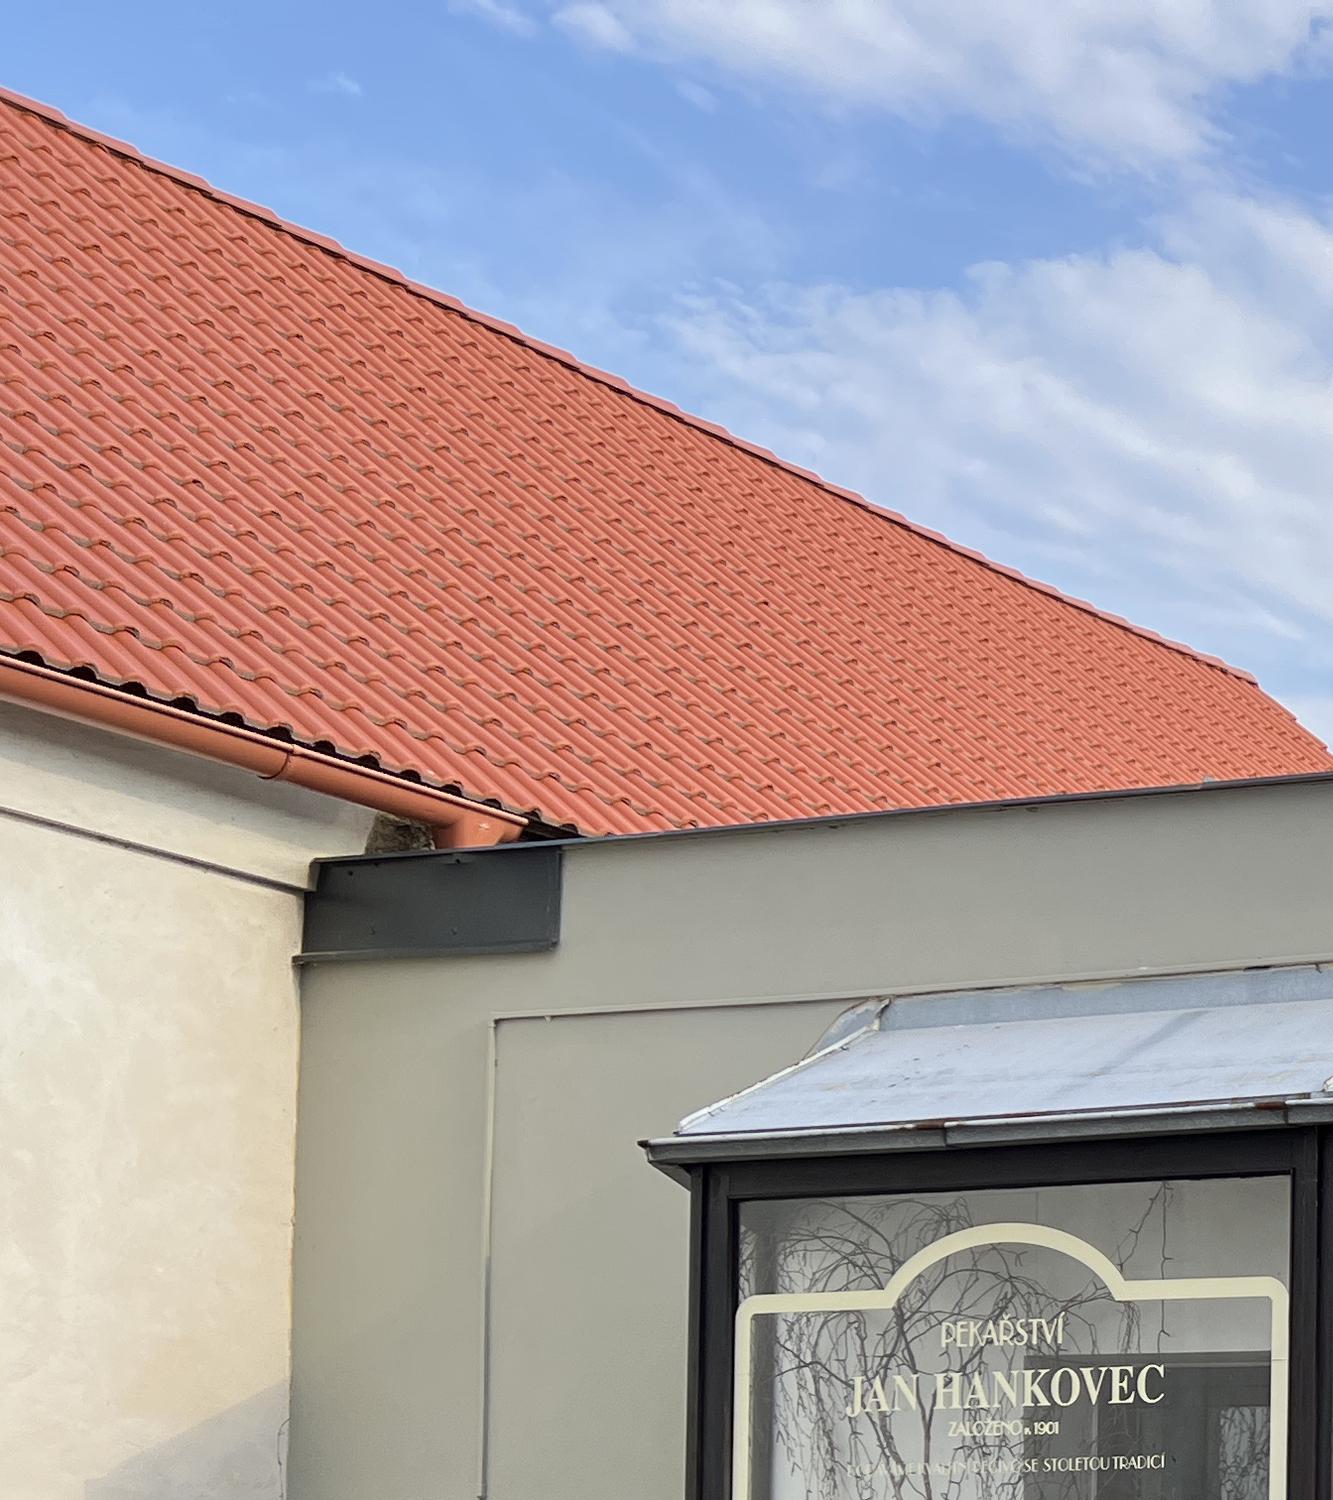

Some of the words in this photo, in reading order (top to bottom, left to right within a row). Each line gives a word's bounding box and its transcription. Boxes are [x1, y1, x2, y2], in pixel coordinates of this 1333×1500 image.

[941, 1310, 1066, 1348] PEKAŘSTVÍ
[845, 1373, 919, 1418] JAN
[934, 1364, 1166, 1410] HANKOVEC
[949, 1414, 1023, 1437] ZALOŽENO
[1033, 1420, 1060, 1436] 1901
[1024, 1458, 1039, 1472] SE
[1042, 1455, 1110, 1472] STOLETOU
[1112, 1451, 1166, 1470] TRADICÍ
